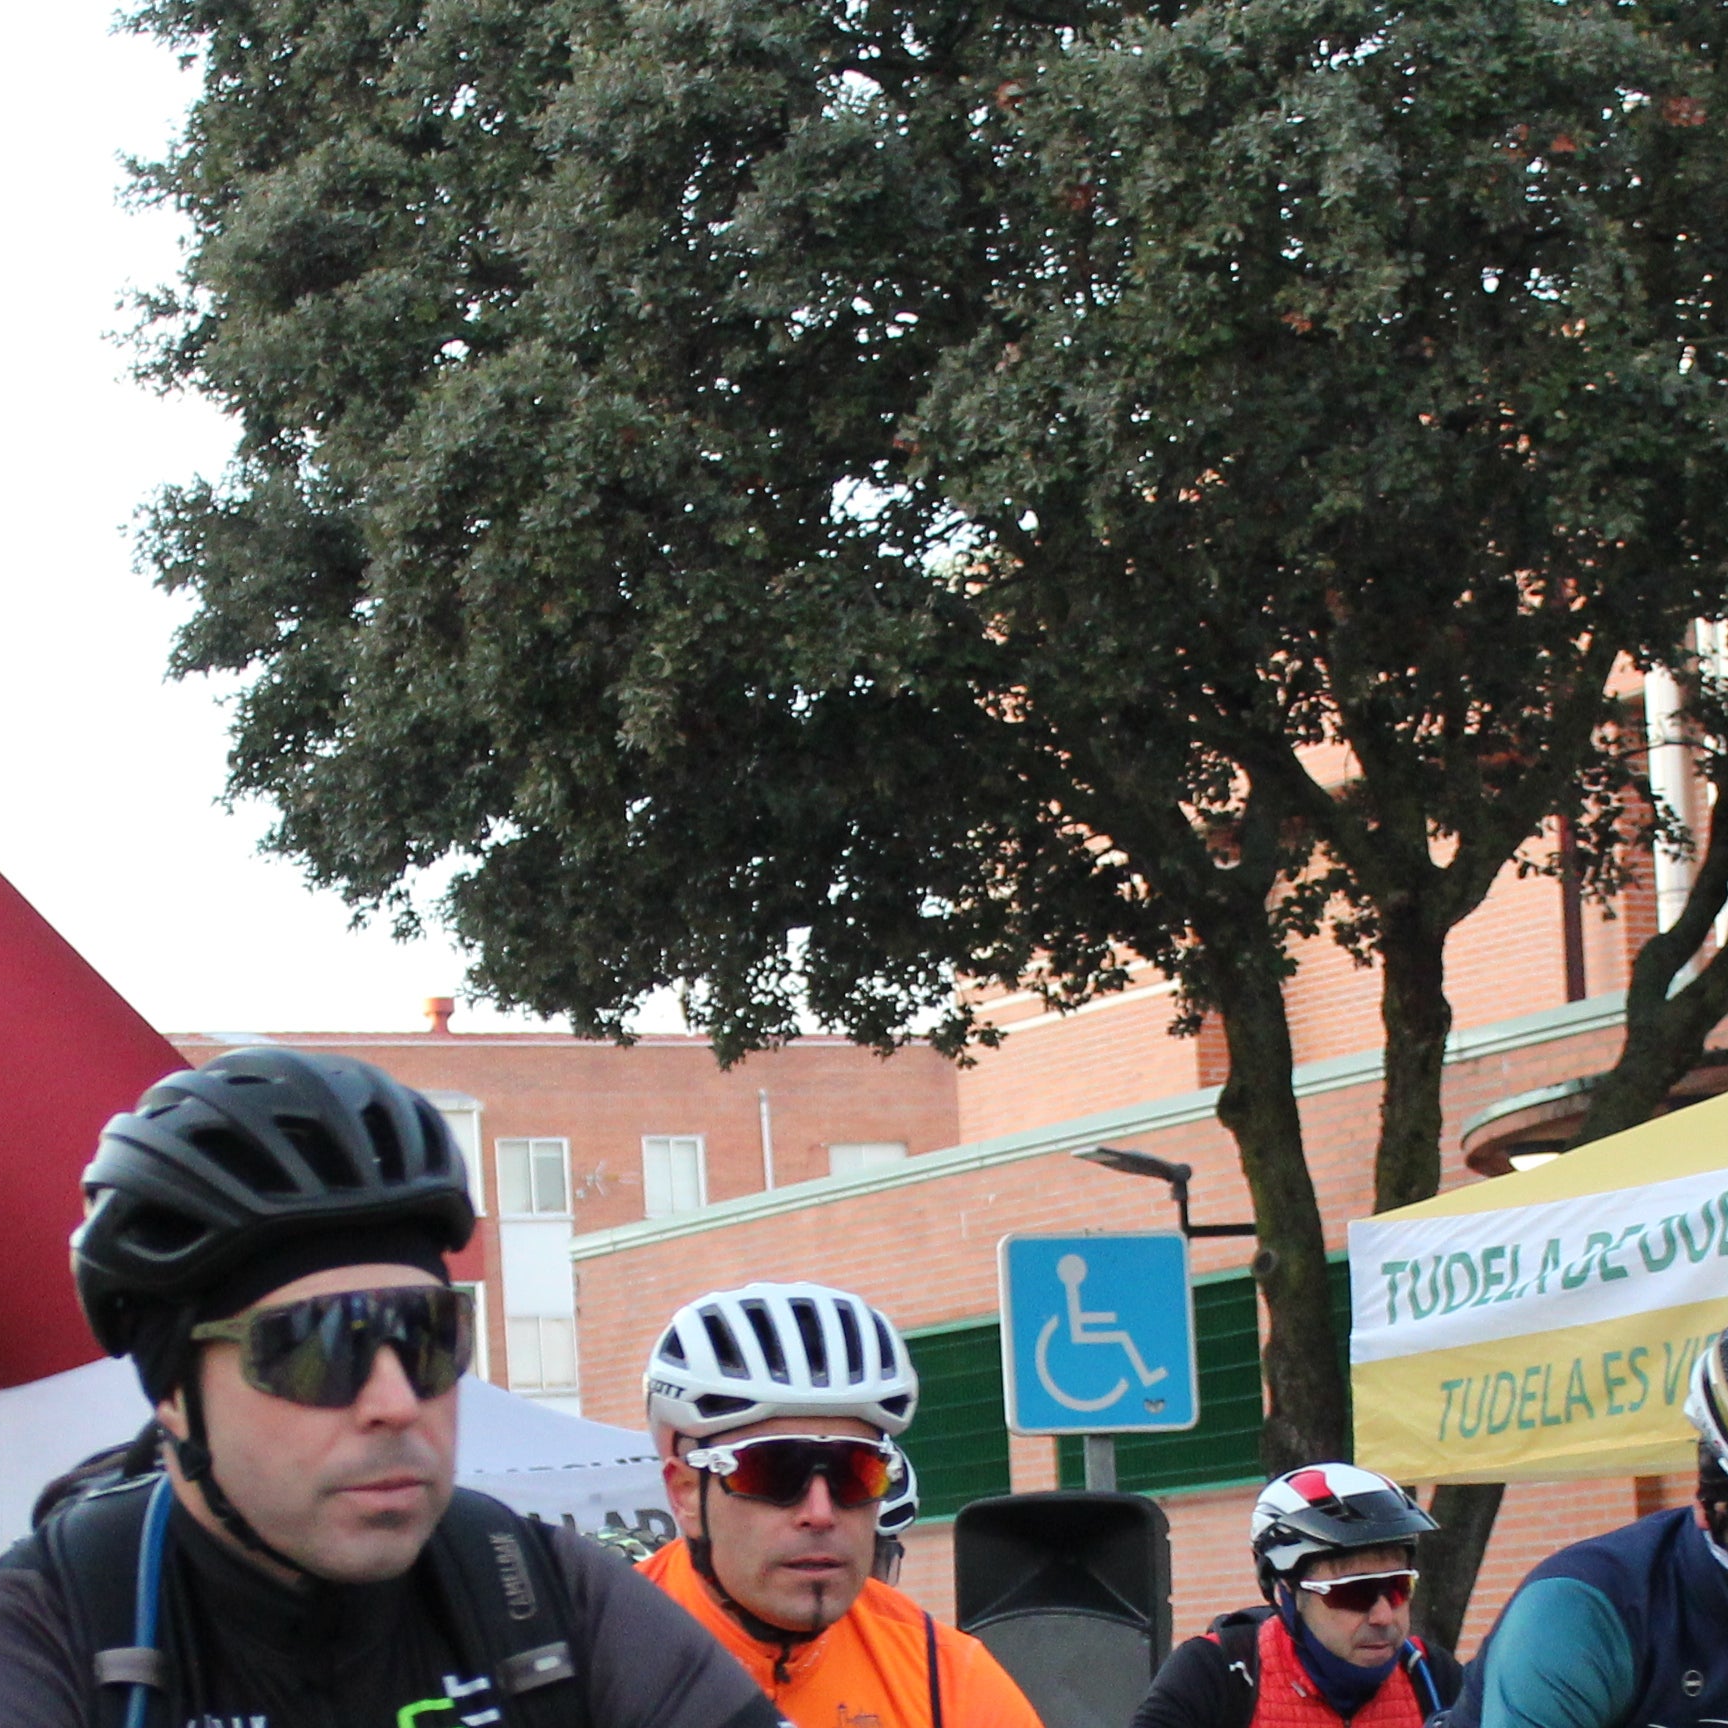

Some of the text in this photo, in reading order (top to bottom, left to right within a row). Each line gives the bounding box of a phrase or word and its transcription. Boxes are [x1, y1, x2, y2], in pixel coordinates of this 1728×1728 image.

[1381, 1238, 1561, 1326] TUDELA
[1561, 1223, 1646, 1290] DE
[1438, 1358, 1596, 1442] TUDELA
[1603, 1346, 1650, 1417] ES
